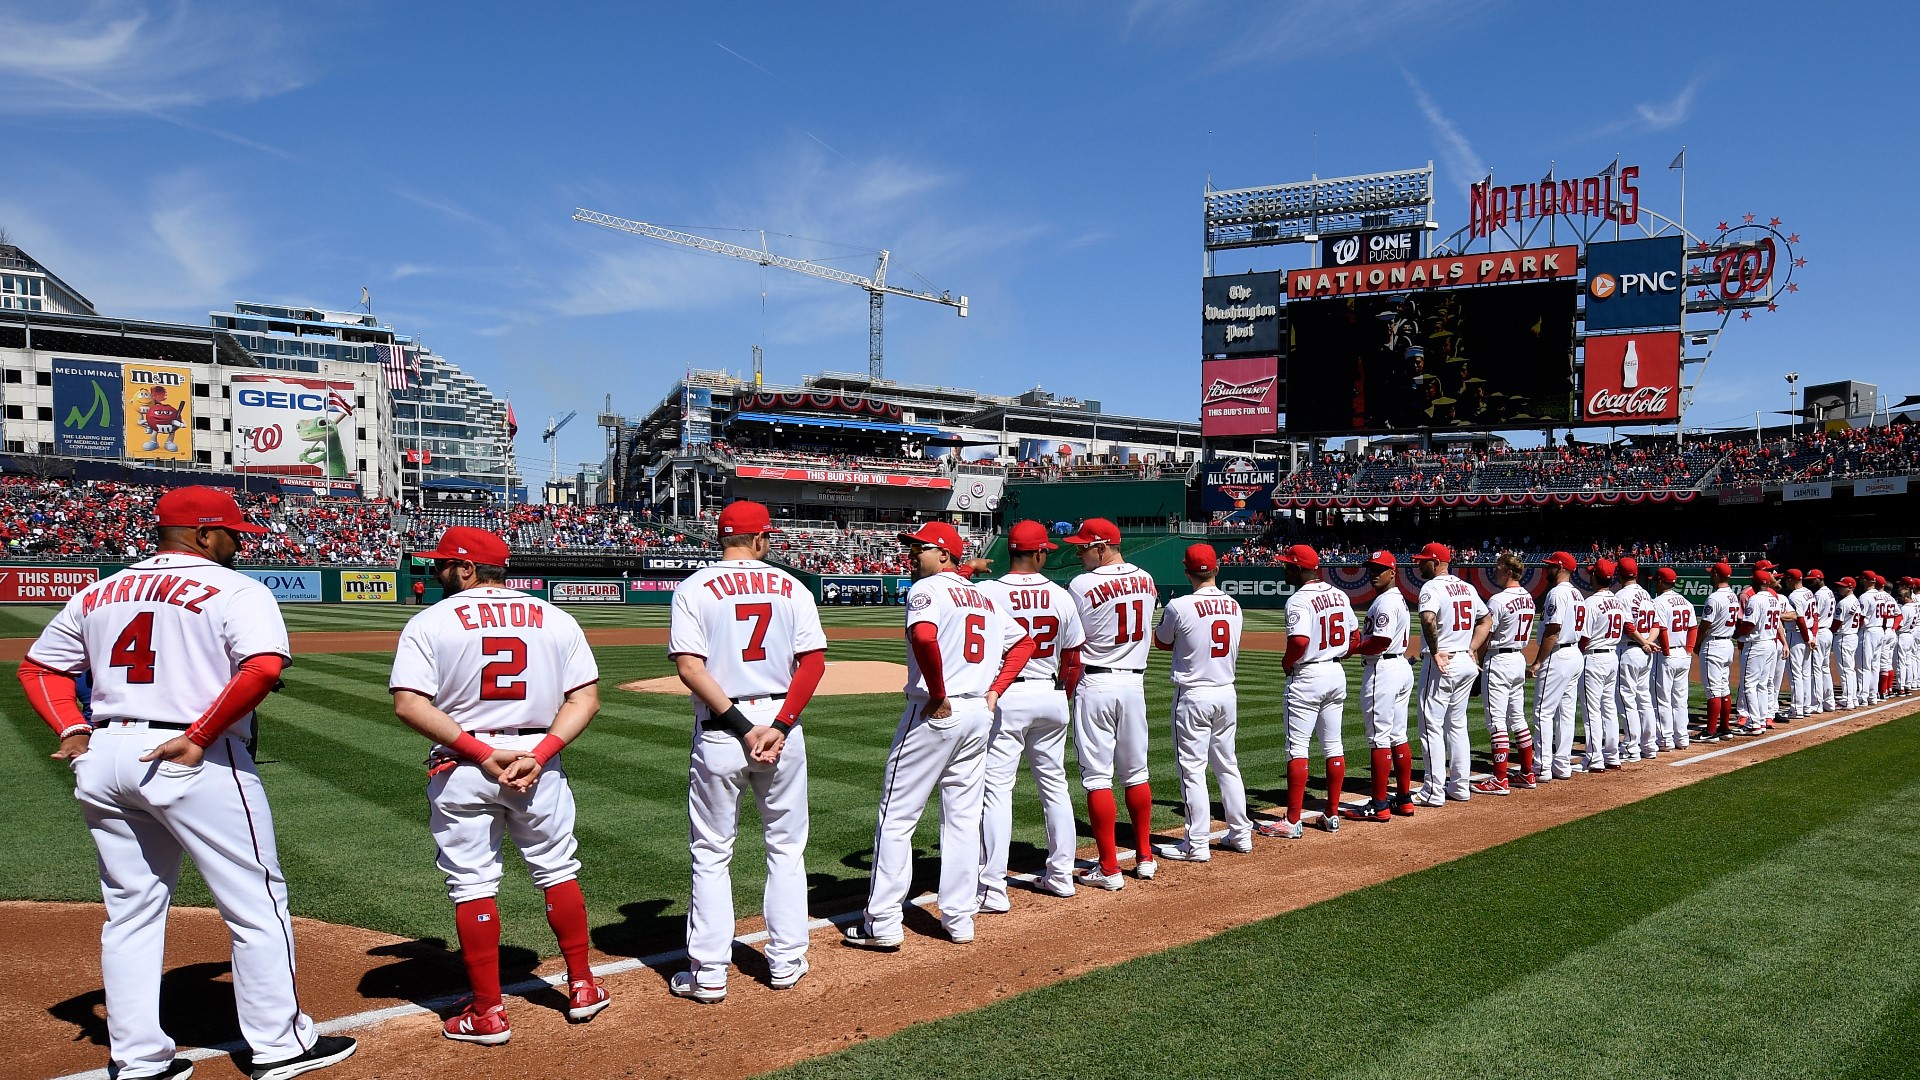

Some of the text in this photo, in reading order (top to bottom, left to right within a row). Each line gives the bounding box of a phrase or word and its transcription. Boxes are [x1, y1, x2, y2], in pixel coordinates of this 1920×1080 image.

[1470, 166, 1638, 239] NATIONALS
[1370, 233, 1411, 250] ONE
[1370, 248, 1411, 262] PURSUIT
[1297, 253, 1560, 290] NATIONALS PARK
[1713, 237, 1776, 300] W
[1229, 285, 1252, 300] The
[1620, 271, 1677, 294] PNC
[1205, 303, 1276, 321] Washington
[1226, 323, 1254, 342] Post
[55, 367, 120, 378] MEDLIMINAL
[1208, 384, 1269, 399] Budweiser
[1588, 386, 1673, 415] Coca-Cola
[1208, 407, 1272, 417] THIS BUD'S FOR YOU.
[283, 479, 311, 487] ADVANCE
[333, 482, 352, 490] SALES
[806, 471, 890, 484] THIS BUD'S FOR YOU.
[1250, 472, 1275, 485] GAME
[1865, 483, 1895, 493] CHAMPIONS
[1793, 488, 1820, 499] CHAMPIONS
[612, 559, 635, 567] 12:46
[16, 572, 95, 585] THIS BUD'S
[703, 571, 793, 601] TURNER
[1220, 580, 1296, 596] GEICO
[17, 586, 48, 597] FOR
[82, 573, 222, 619] MARTINEZ
[947, 587, 996, 614] RENDON
[1009, 589, 1050, 611] SOTO
[1444, 584, 1472, 597] ADAMS
[1194, 599, 1238, 619] DOZIER
[1311, 592, 1346, 614] ROBLES
[454, 602, 544, 630] EATON
[1114, 599, 1144, 645] 11
[1452, 600, 1473, 632] 15
[1513, 613, 1534, 641] 17
[1604, 613, 1622, 639] 19
[1637, 609, 1656, 633] 20
[1671, 609, 1691, 632] 28
[1764, 610, 1780, 630] 36
[735, 602, 773, 662] 7
[963, 613, 986, 664] 6
[1210, 619, 1231, 659] 9
[1319, 611, 1346, 651] 16
[109, 611, 157, 684] 4
[480, 636, 528, 700] 2
